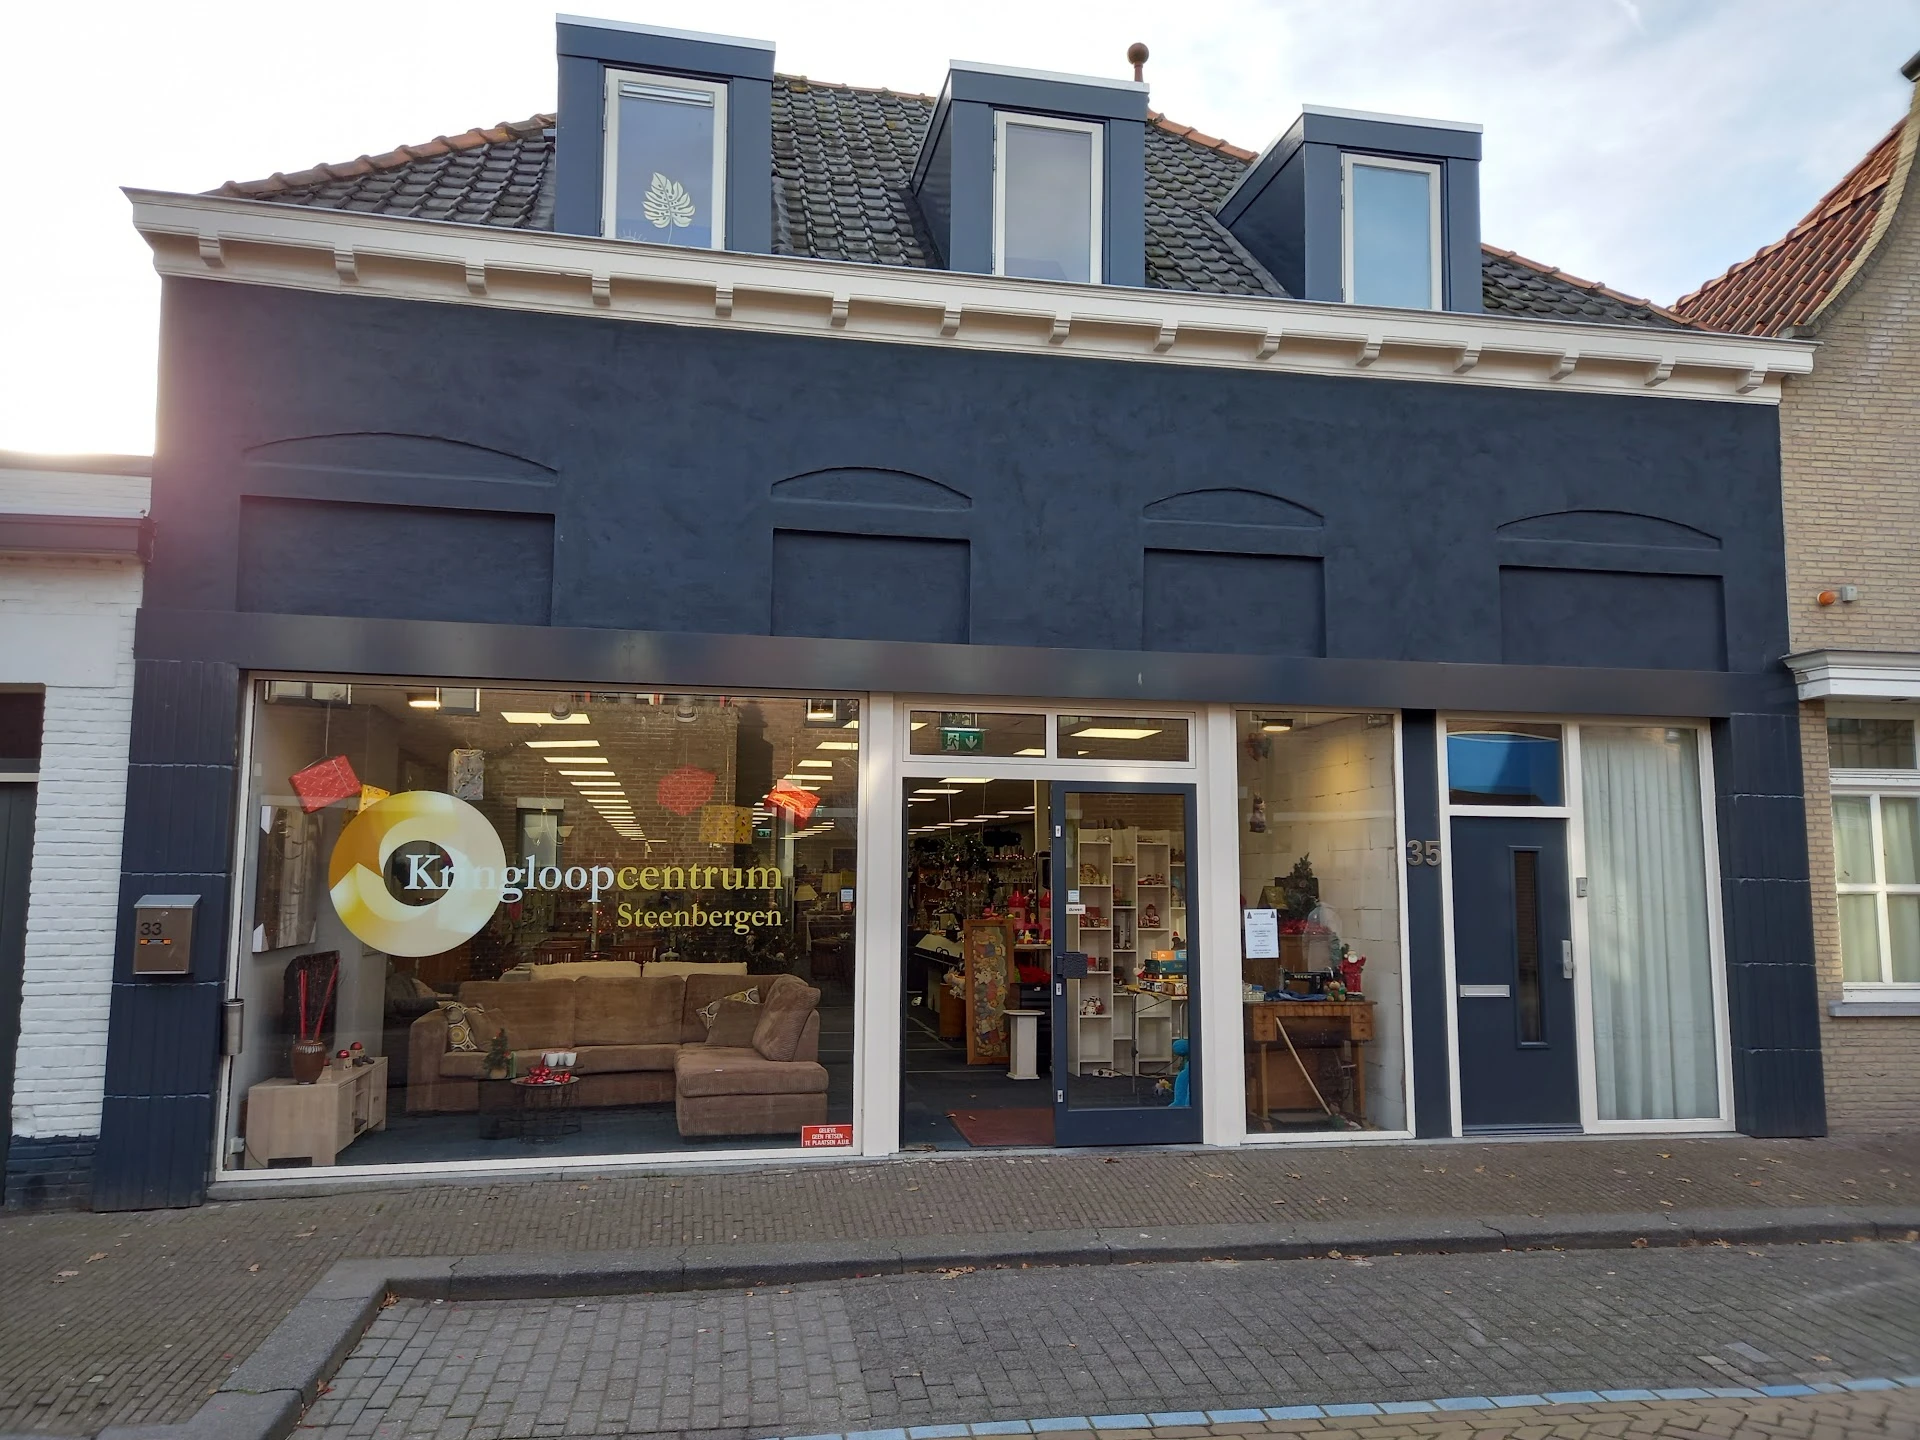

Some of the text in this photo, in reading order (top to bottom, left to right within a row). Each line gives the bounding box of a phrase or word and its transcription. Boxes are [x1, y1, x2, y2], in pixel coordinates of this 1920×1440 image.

[1407, 839, 1441, 867] 35
[404, 854, 784, 903] Kringloopcentrum
[140, 922, 162, 936] 33
[617, 902, 783, 935] Steenbergen
